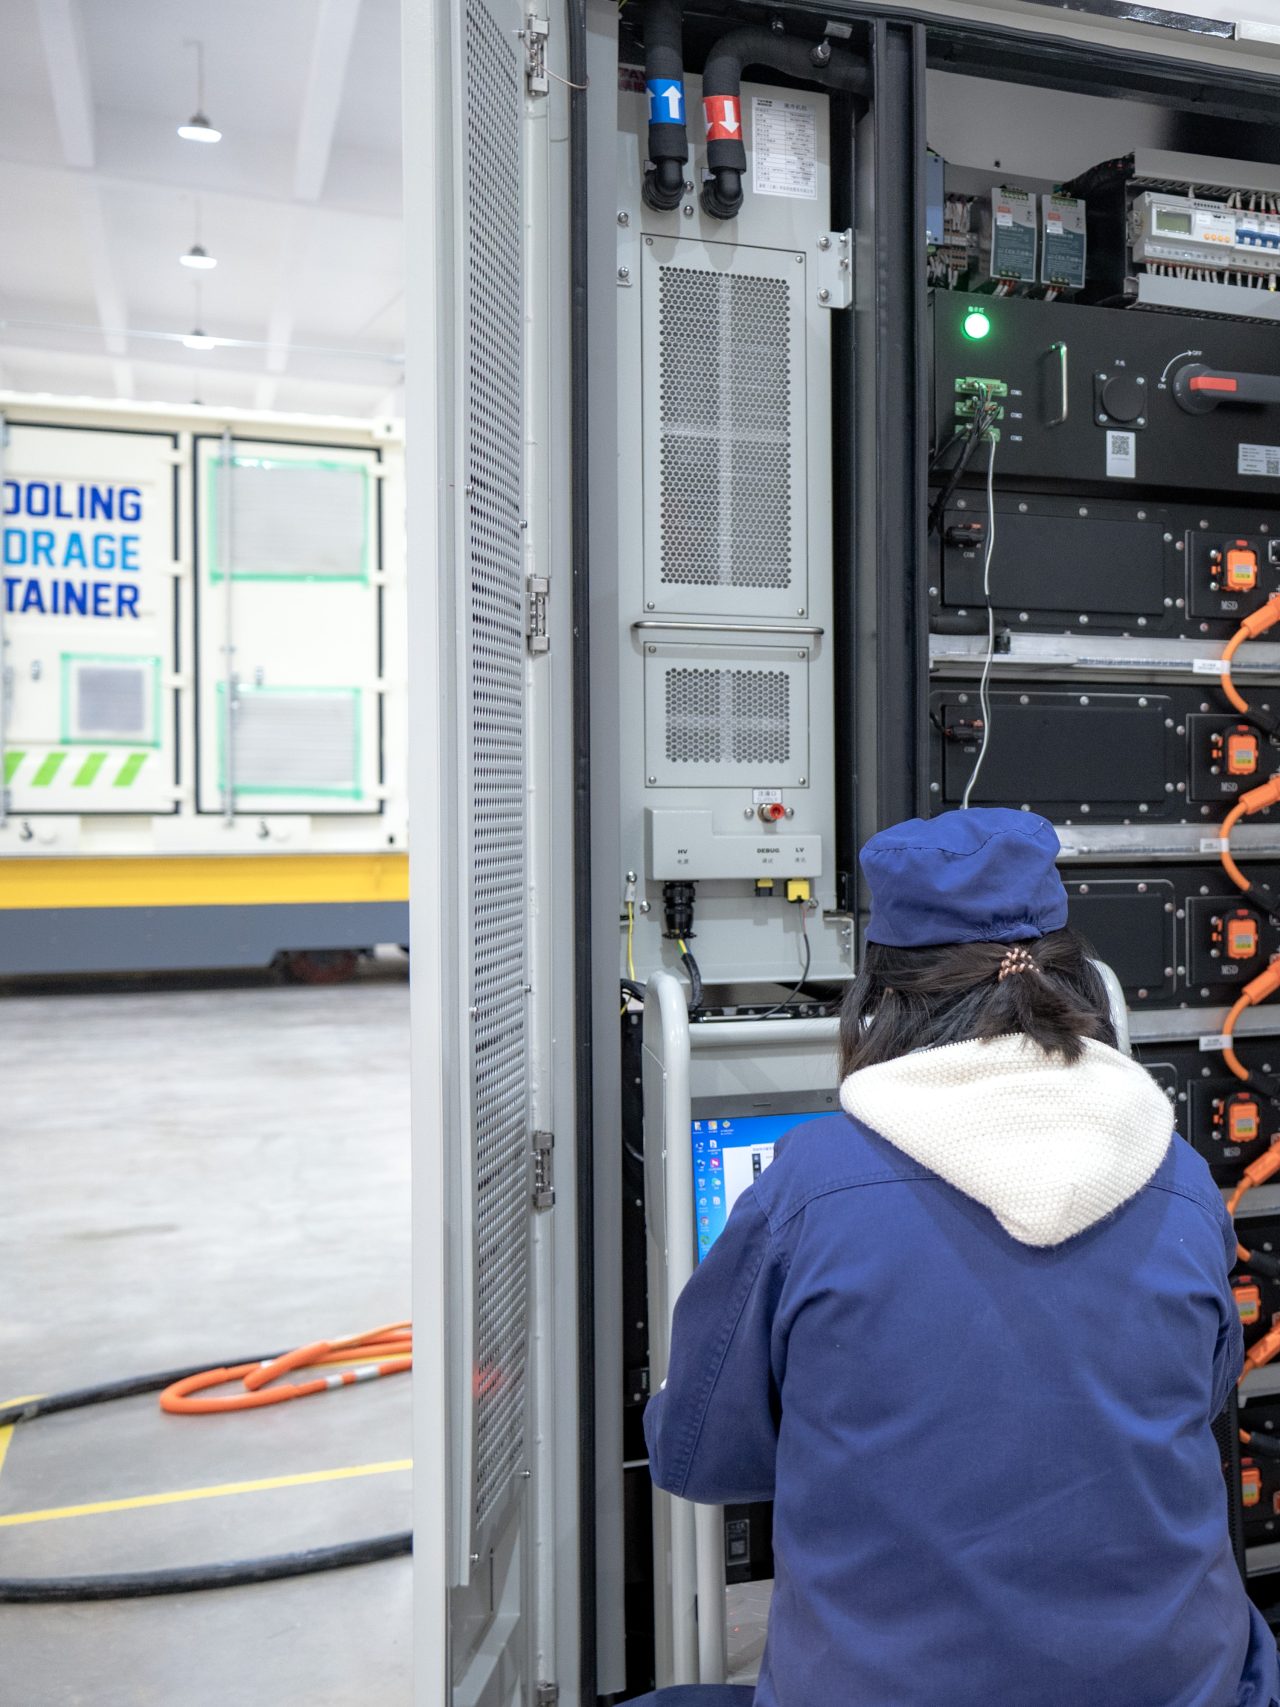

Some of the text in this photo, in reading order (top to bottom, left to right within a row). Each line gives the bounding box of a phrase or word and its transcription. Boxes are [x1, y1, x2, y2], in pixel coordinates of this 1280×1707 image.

[1220, 600, 1239, 610] MSD
[1220, 782, 1239, 792] MSD
[1221, 965, 1239, 975] MSD
